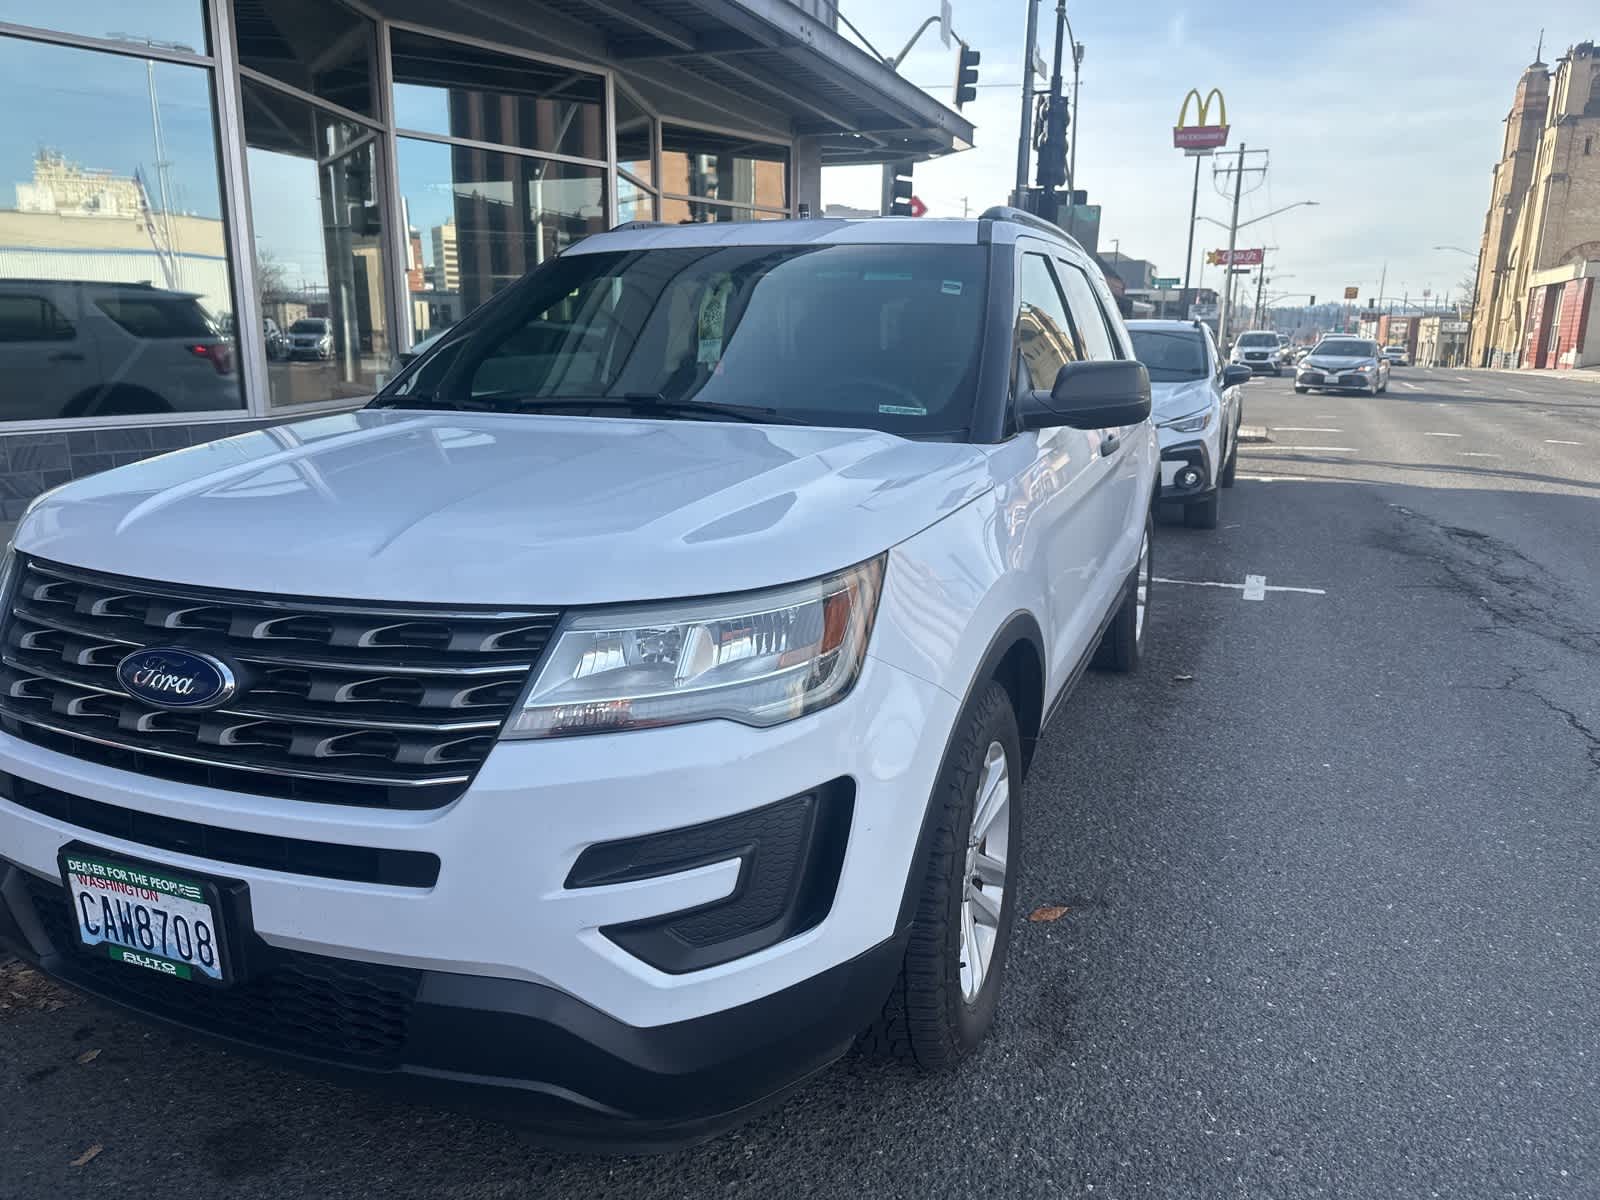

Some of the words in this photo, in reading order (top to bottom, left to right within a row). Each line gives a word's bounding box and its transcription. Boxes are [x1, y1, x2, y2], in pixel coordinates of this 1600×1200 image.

[132, 655, 201, 696] Ford
[76, 874, 159, 902] WASHINGTON
[107, 866, 128, 881] FOR
[128, 872, 149, 886] THE
[79, 891, 215, 968] CAW8708
